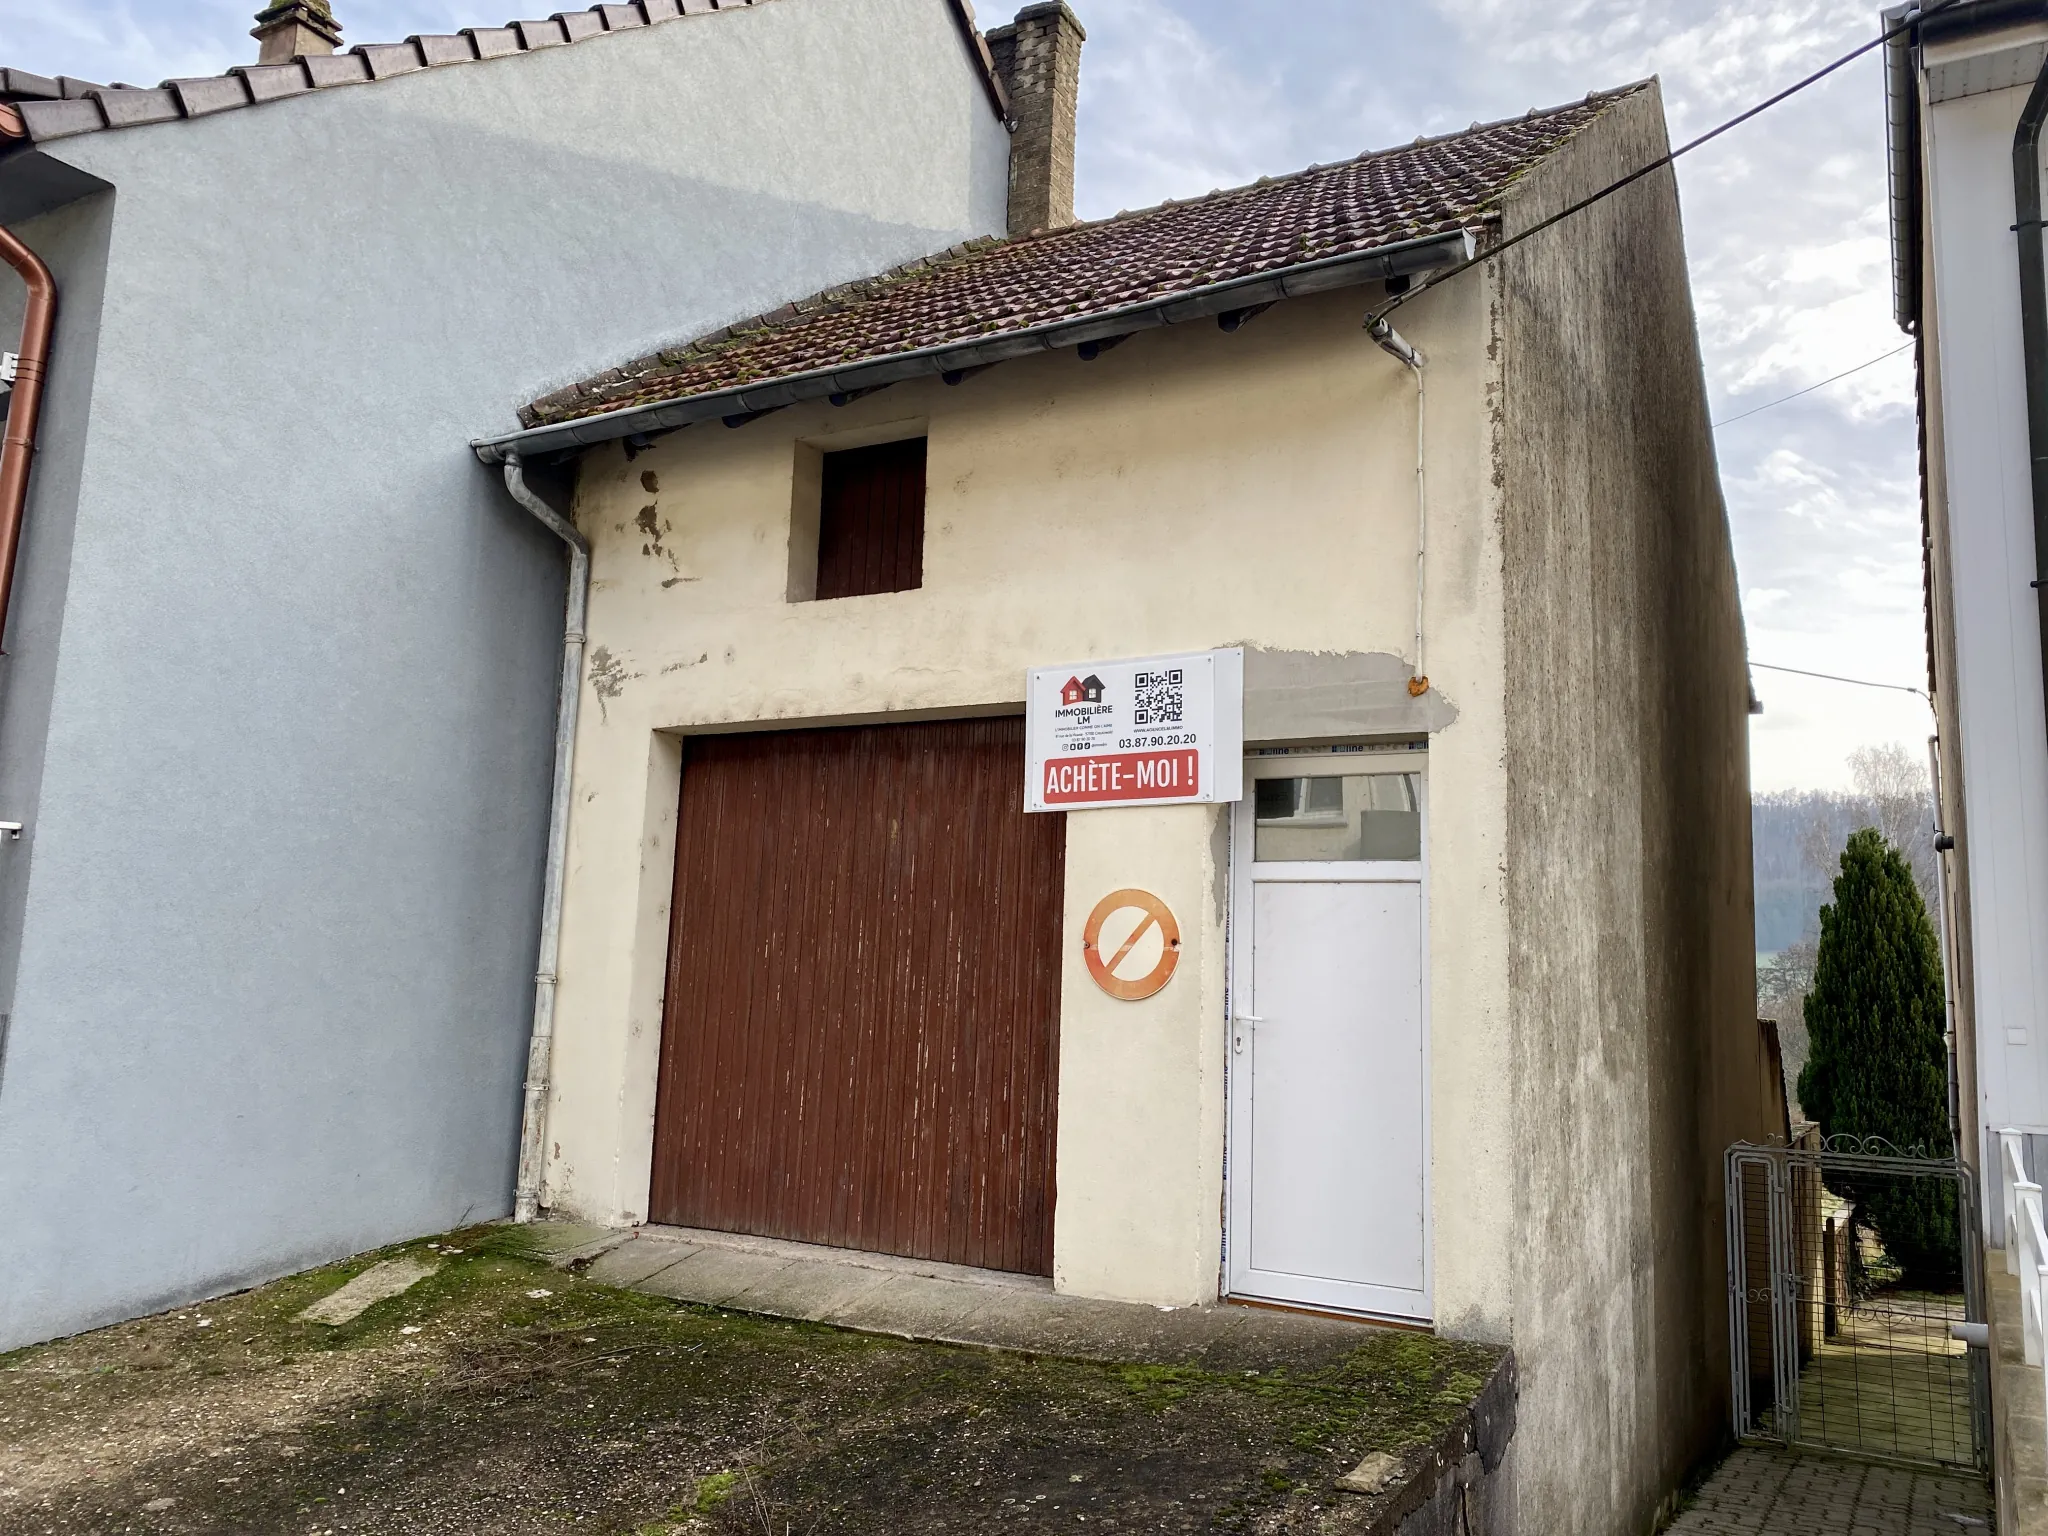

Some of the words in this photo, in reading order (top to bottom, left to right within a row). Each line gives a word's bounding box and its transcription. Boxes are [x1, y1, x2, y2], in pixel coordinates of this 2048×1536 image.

[1055, 705, 1113, 718] IMMOBILIÈRE
[1077, 716, 1091, 725] LM
[1118, 733, 1197, 748] 03.87.90.20.20
[1046, 758, 1178, 794] ACHÈTE-MOI
